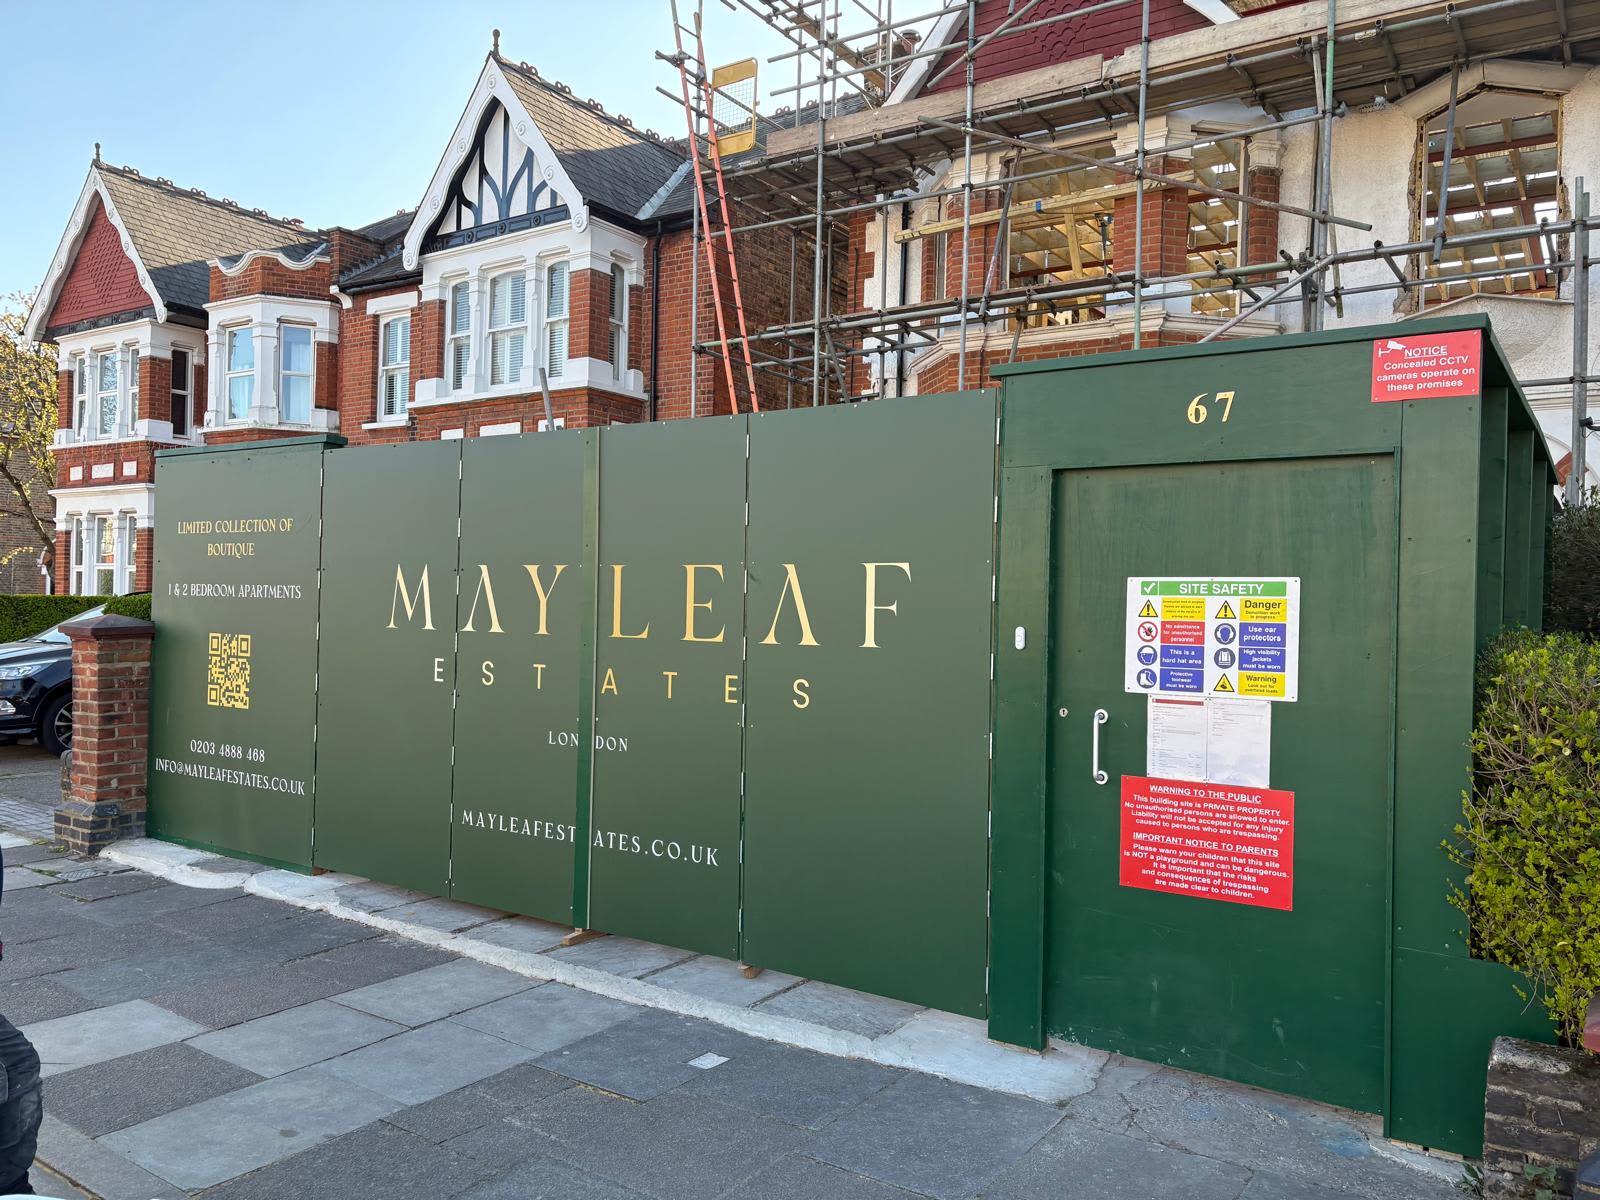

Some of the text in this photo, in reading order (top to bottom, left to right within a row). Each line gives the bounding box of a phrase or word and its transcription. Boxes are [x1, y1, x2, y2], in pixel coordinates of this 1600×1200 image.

[1405, 346, 1448, 356] NOTICE
[1384, 356, 1468, 370] Concealed CCTV
[1377, 372, 1418, 381] cameras
[1421, 369, 1459, 378] operate
[1387, 379, 1463, 391] these premises
[1188, 391, 1235, 424] 67
[178, 519, 293, 534] LIMITED COLLECTION OF
[208, 543, 255, 558] BOUTIQUE
[175, 584, 179, 596] &
[183, 584, 187, 595] 2
[191, 584, 235, 597] BEDROOM
[238, 584, 301, 599] APARTMENTS
[1180, 584, 1264, 594] SITE SAFETY
[386, 562, 912, 648] MAYLEAF
[1244, 600, 1281, 610] Danger
[433, 658, 810, 708] ESTATES
[1246, 675, 1277, 683] Warning
[549, 731, 628, 751] LONDON
[190, 740, 265, 762] 0203 4888 468
[155, 758, 305, 795] INFO@MAYLEAFESTATES.CO.UK
[1150, 784, 1190, 795] WARNING
[1228, 792, 1261, 803] PUBLIC
[1134, 794, 1147, 802] This
[1150, 797, 1178, 806] building
[1203, 803, 1235, 811] PRIVATE
[1136, 804, 1182, 813] unauthorised
[1132, 810, 1158, 819] Liability
[1199, 819, 1231, 827] accepted
[1262, 825, 1283, 834] injury
[462, 810, 719, 866] MAYLEAFESTATES.CO.UK
[1133, 832, 1183, 844] IMPORTANT
[1186, 839, 1218, 848] NOTICE
[1236, 845, 1279, 856] PARENTS
[1233, 830, 1279, 841] trespassing.
[1133, 844, 1157, 852] Please
[1198, 852, 1229, 861] children
[1156, 855, 1198, 865] playground
[1244, 867, 1289, 878] dangerous.
[1168, 864, 1204, 874] important
[1238, 874, 1256, 882] risks
[1157, 871, 1211, 884] consequences
[1223, 880, 1269, 893] trespassing
[1221, 888, 1255, 898] children.
